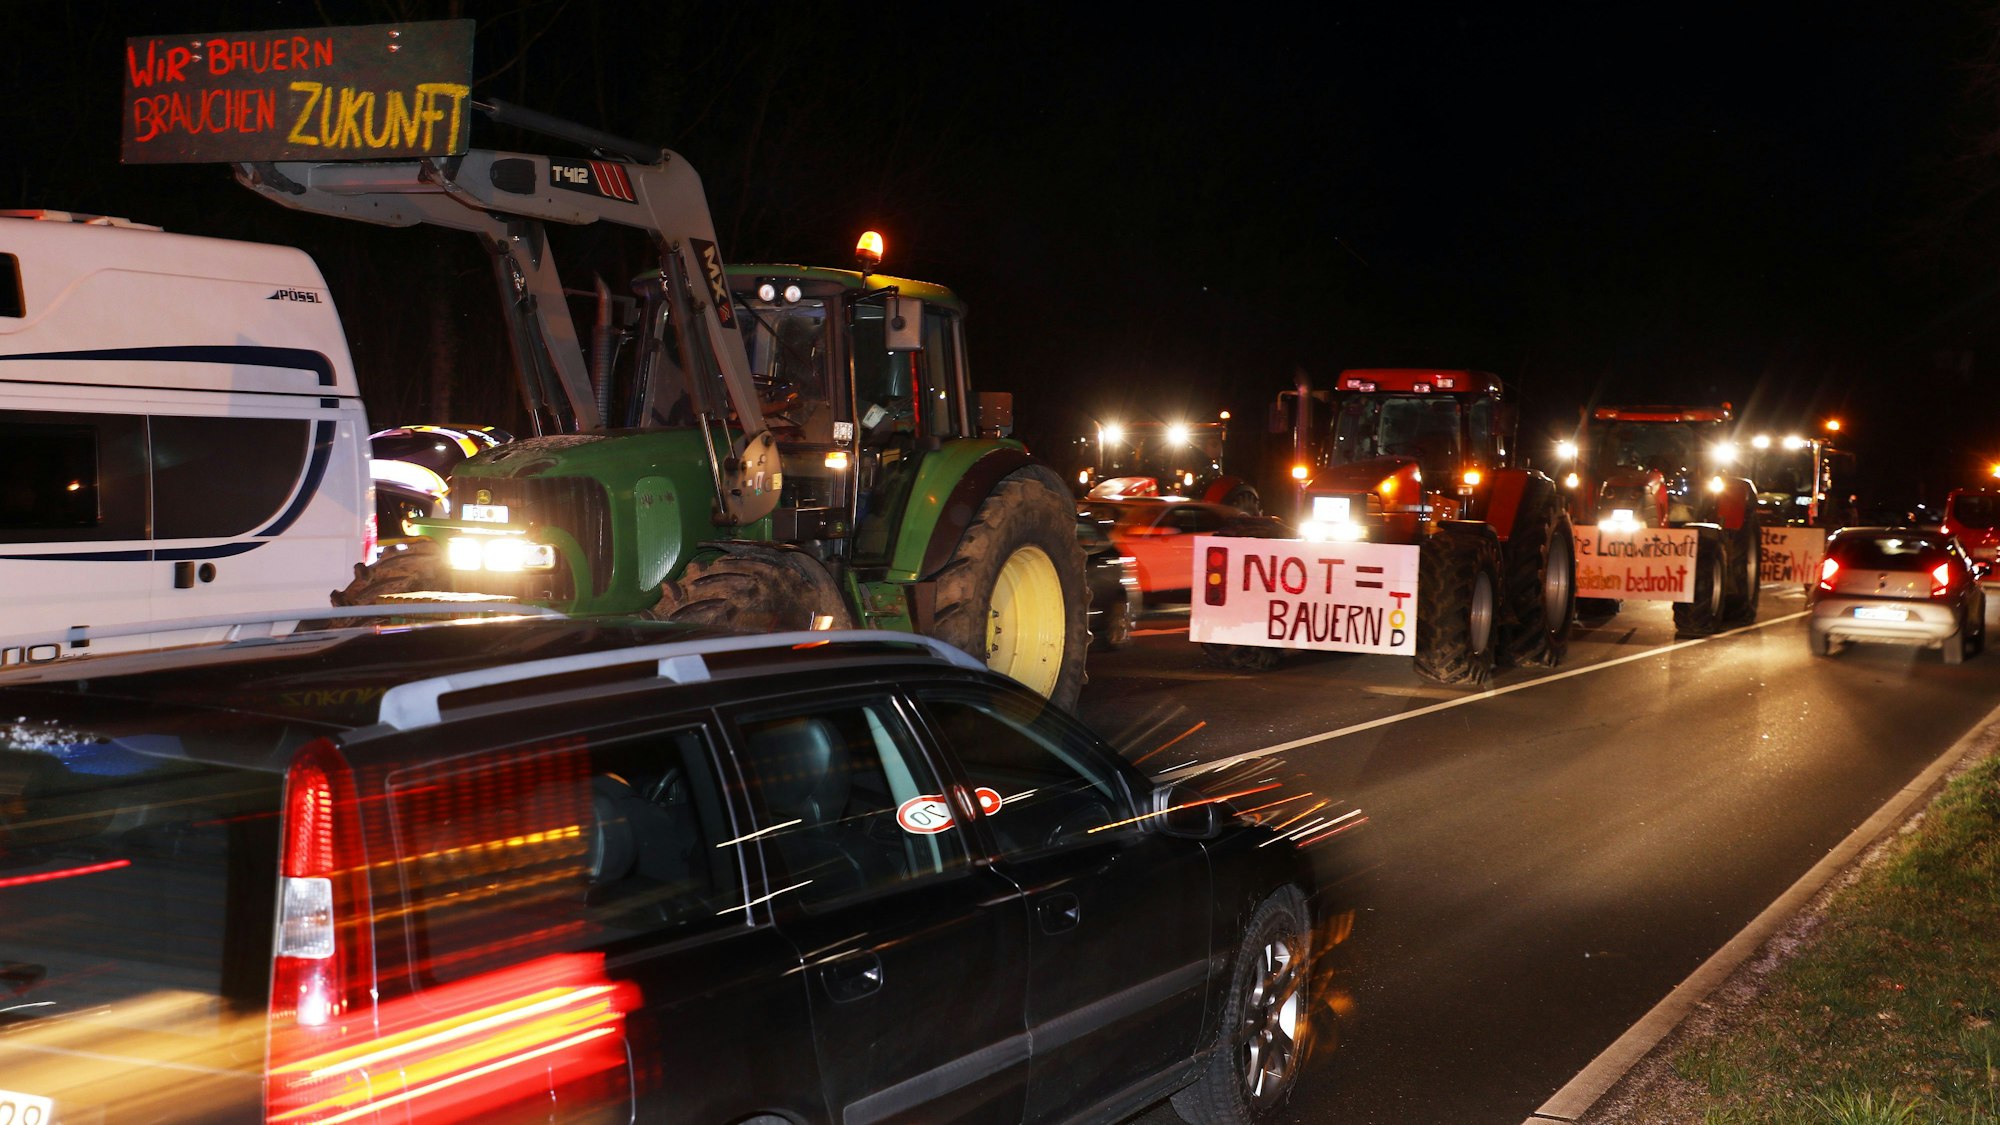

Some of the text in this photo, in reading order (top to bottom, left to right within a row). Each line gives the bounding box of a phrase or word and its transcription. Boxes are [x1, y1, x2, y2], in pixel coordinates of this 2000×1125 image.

[206, 36, 333, 75] BAUERN
[134, 81, 470, 156] BRAUCHEN ZUKUNFT
[279, 287, 323, 304] PÖSSL
[1242, 553, 1346, 595] NOT
[1625, 565, 1688, 593] bedroht
[1267, 599, 1384, 646] BAUERN
[1388, 591, 1412, 647] TOD
